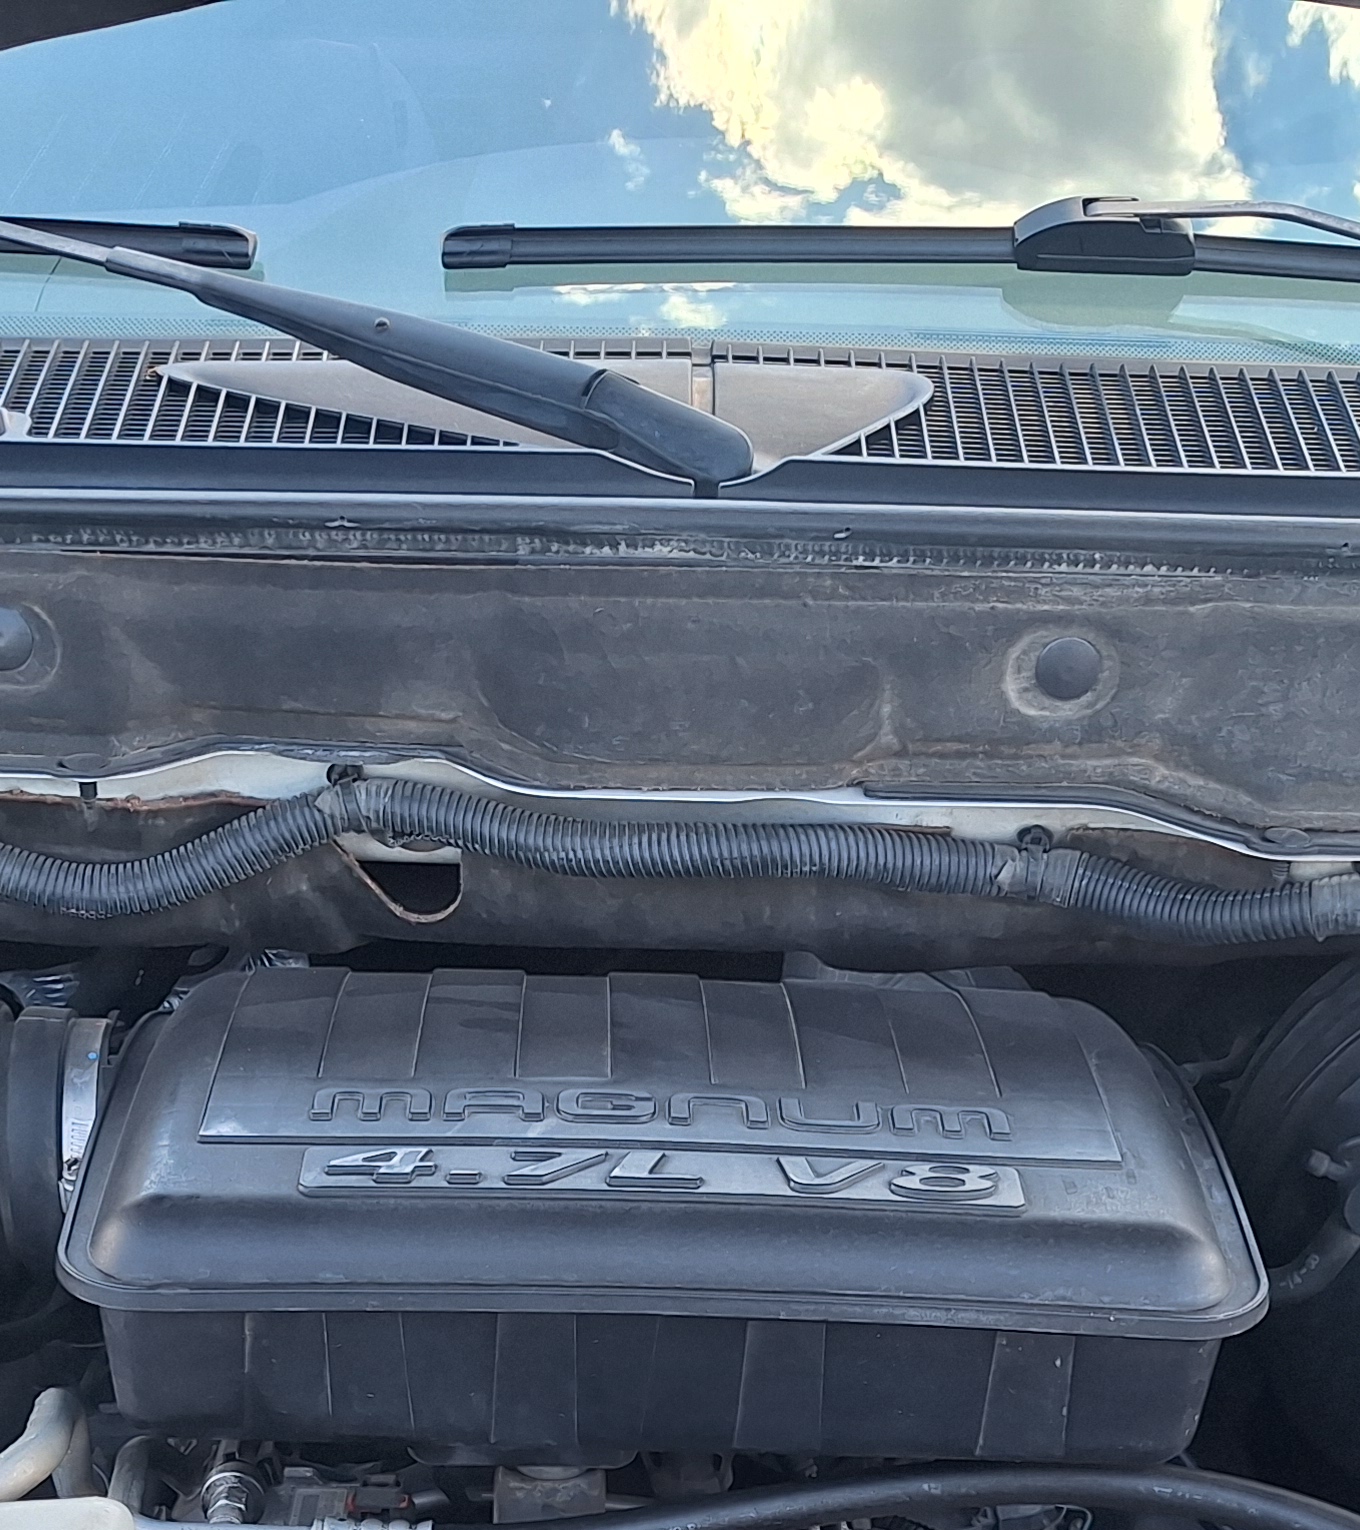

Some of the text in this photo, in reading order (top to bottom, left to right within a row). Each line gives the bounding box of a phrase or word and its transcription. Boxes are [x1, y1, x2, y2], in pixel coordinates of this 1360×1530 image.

[311, 1083, 1014, 1142] MAGNUM
[321, 1145, 1005, 1202] 4.7L V8
